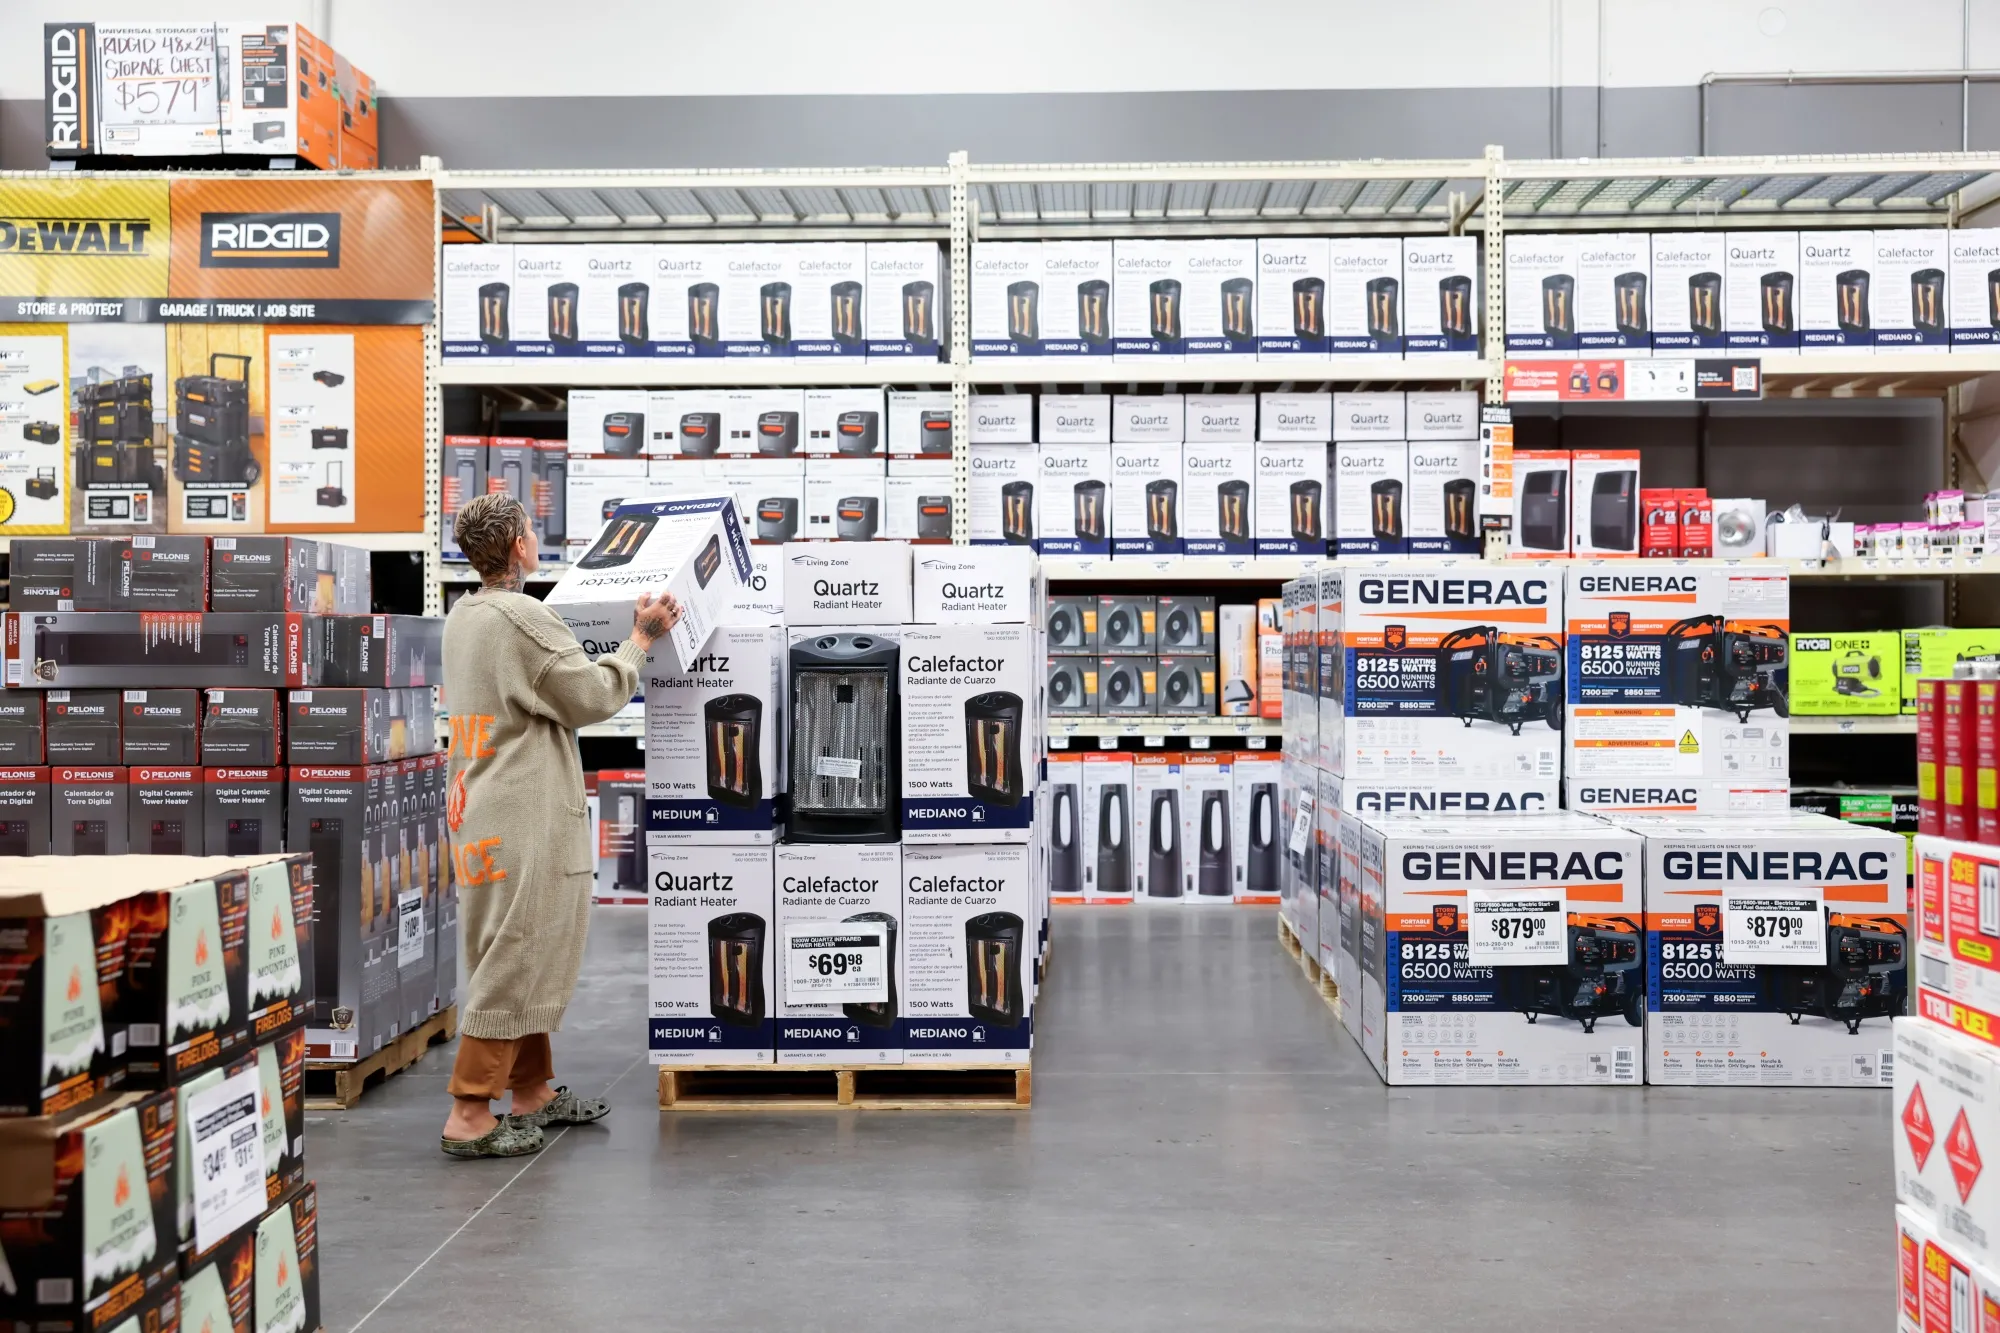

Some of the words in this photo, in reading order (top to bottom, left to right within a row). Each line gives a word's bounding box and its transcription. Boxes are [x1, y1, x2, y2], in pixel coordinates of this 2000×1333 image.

[170, 55, 213, 74] CHEST
[51, 28, 77, 150] RIDGID
[212, 224, 330, 249] RIDGID
[1409, 252, 1453, 265] Quartz
[1510, 253, 1564, 264] Calefactor
[1730, 248, 1775, 261] Quartz
[1806, 246, 1850, 259] Quartz
[1878, 248, 1934, 258] Calefactor
[588, 259, 632, 272] Quartz
[799, 260, 852, 271] Calefactor
[975, 260, 1028, 270] Calefactor
[1118, 258, 1172, 269] Calefactor
[1263, 254, 1307, 266] Quartz
[447, 261, 500, 272] Calefactor
[18, 303, 57, 315] STORE
[59, 304, 68, 315] &
[71, 303, 123, 316] PROTECT
[160, 304, 208, 317] GARAGE
[217, 304, 255, 317] TRUCK
[264, 304, 286, 317] JOB
[289, 304, 315, 317] SITE
[978, 416, 1015, 427] Quartz
[1278, 414, 1315, 425] Quartz
[1424, 413, 1462, 424] Quartz
[973, 458, 1015, 470] Quartz
[1045, 457, 1087, 469] Quartz
[1116, 457, 1159, 469] Quartz
[1341, 456, 1384, 468] Quartz
[669, 501, 721, 512] MEDIANO
[807, 560, 828, 568] Living
[577, 573, 669, 586] Calefactor
[1580, 577, 1697, 592] GENERAC
[814, 579, 879, 597] Quartz
[942, 583, 1004, 599] Quartz
[1359, 580, 1548, 605] GENERAC
[814, 601, 848, 609] Radiant
[852, 601, 882, 609] Heater
[942, 603, 975, 611] Radiant
[978, 603, 1007, 611] Heater
[568, 620, 590, 628] Living
[1796, 639, 1831, 650] RYOBI
[1581, 645, 1624, 659] 8125
[908, 656, 1004, 672] Calefactor
[1357, 658, 1400, 672] 8125
[1581, 661, 1624, 675] 6500
[651, 678, 693, 688] Radiant
[697, 678, 734, 688] Heater
[908, 677, 947, 685] Radiante
[950, 677, 961, 685] de
[1357, 675, 1400, 689] 6500
[1401, 681, 1436, 689] WATTS
[1135, 756, 1166, 764] Lasko
[299, 788, 322, 796] Digital
[1580, 788, 1697, 804] GENERAC
[1356, 792, 1544, 810] GENERAC
[653, 810, 702, 819] MEDIUM
[909, 809, 967, 818] MEDIANO
[1403, 852, 1624, 881] GENERAC
[1663, 851, 1888, 880] GENERAC
[655, 871, 733, 891] Quartz
[783, 876, 878, 893] Calefactor
[909, 875, 1005, 892] Calefactor
[655, 897, 697, 906] Radiant
[701, 897, 737, 906] Heater
[909, 897, 948, 905] Radiante
[951, 897, 962, 905] de
[964, 897, 996, 905] Cuarzo
[269, 946, 286, 958] PINE
[1402, 944, 1451, 959] 8125
[257, 956, 296, 979] MOUNTAIN
[1401, 963, 1451, 979] 6500
[1453, 970, 1493, 979] WATTS
[256, 1008, 292, 1034] FIRELOGS
[655, 1029, 704, 1038] MEDIUM
[784, 1029, 842, 1038] MEDIANO
[909, 1029, 967, 1038] MEDIANO
[176, 1038, 220, 1073] FIRELOGS
